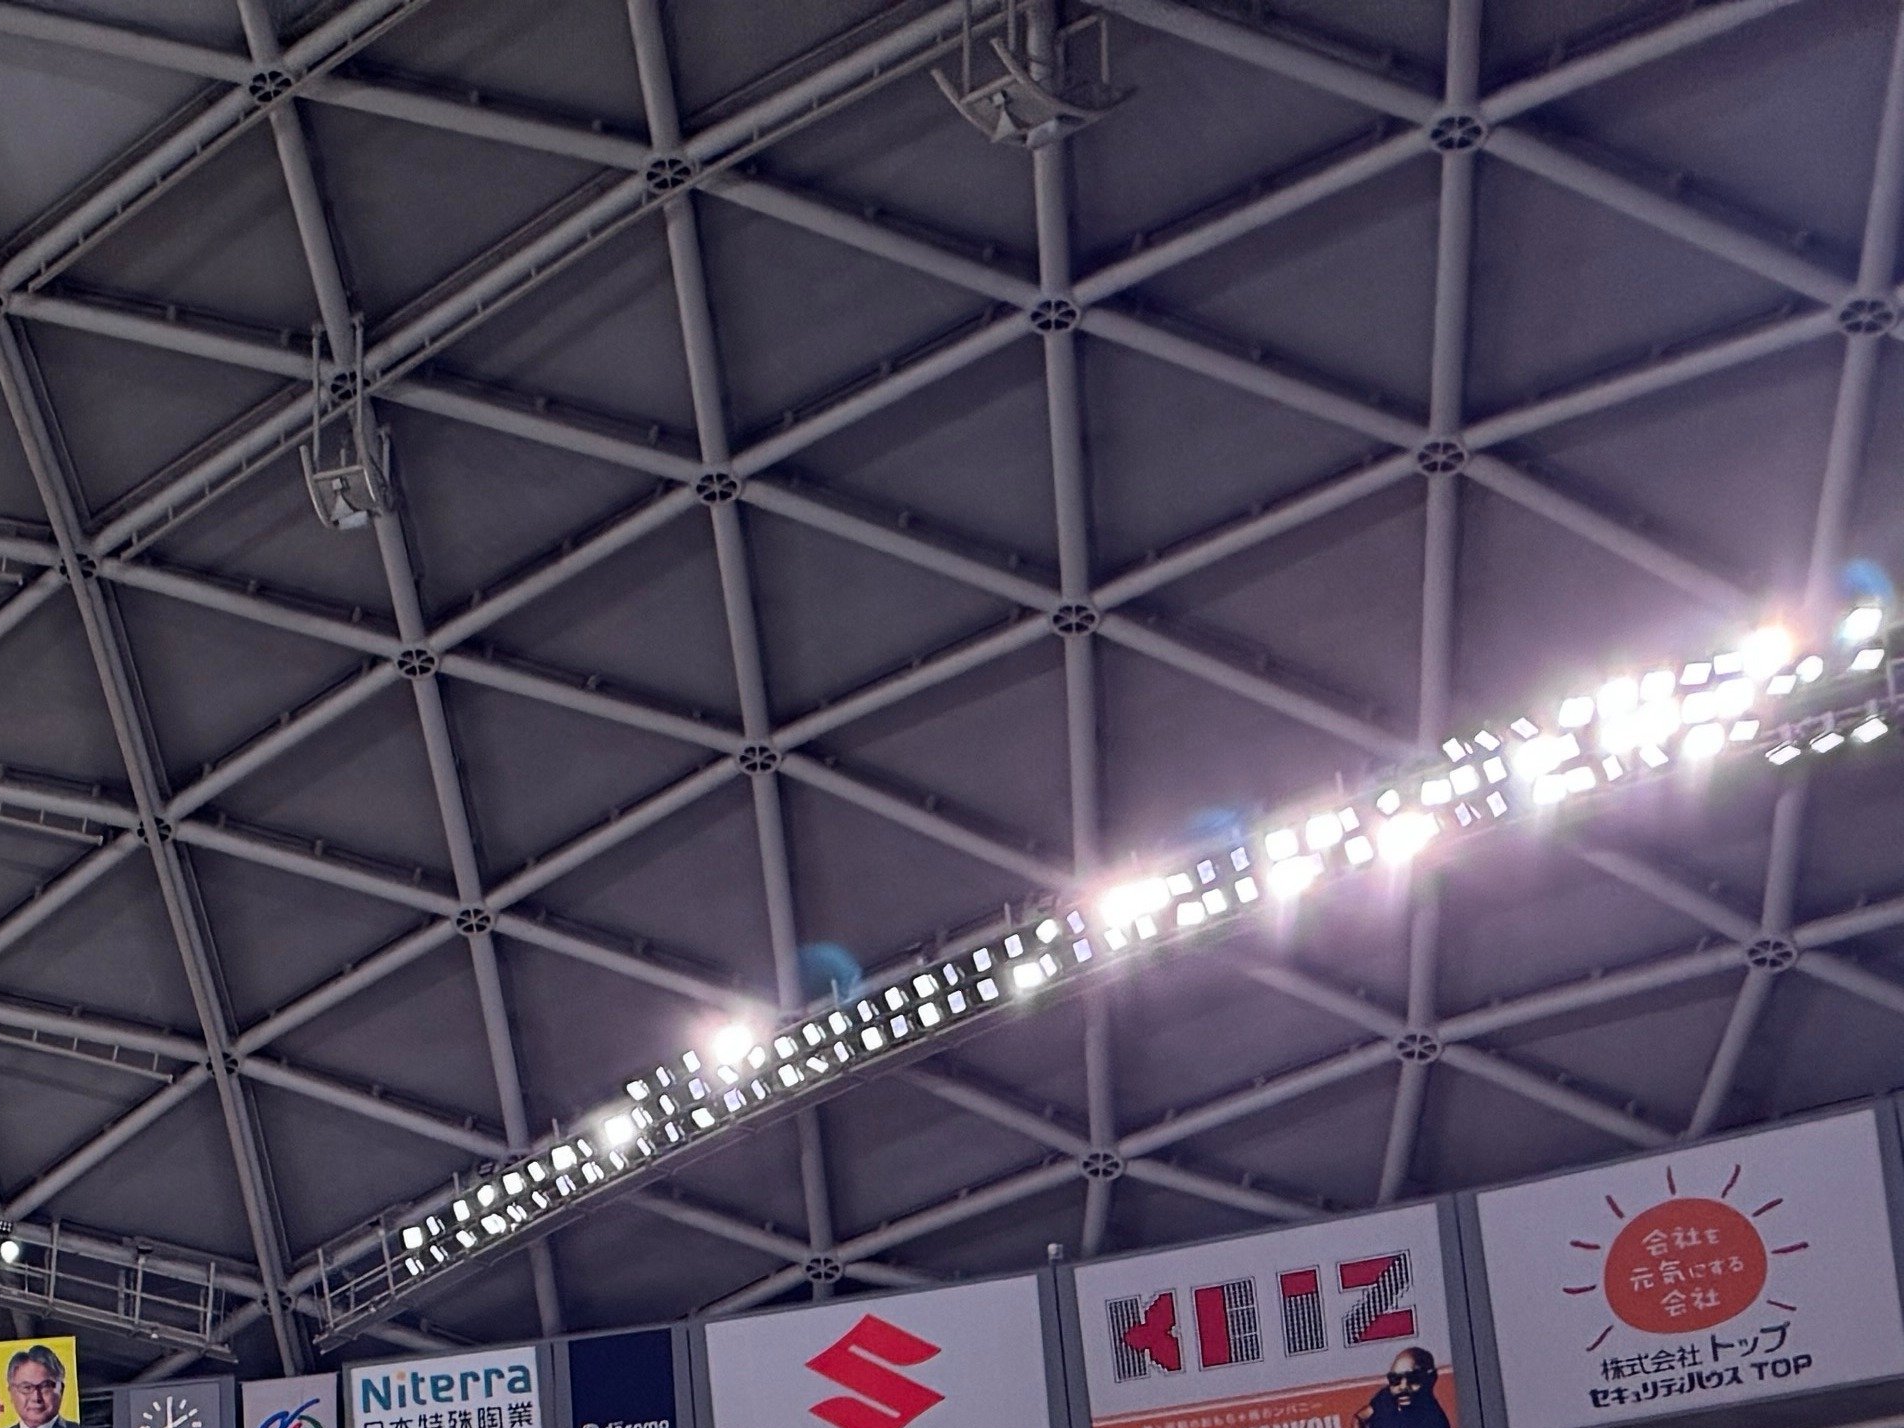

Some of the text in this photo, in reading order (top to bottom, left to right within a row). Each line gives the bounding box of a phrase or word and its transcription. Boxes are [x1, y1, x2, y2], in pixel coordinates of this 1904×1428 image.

[1642, 1226, 1720, 1257] 会社を
[1629, 1256, 1745, 1292] 元気にする
[1660, 1287, 1722, 1318] 会社
[1600, 1344, 1703, 1381] 株式会社
[361, 1364, 532, 1415] Niterra
[1588, 1353, 1813, 1409] セキュリティハウス TOP
